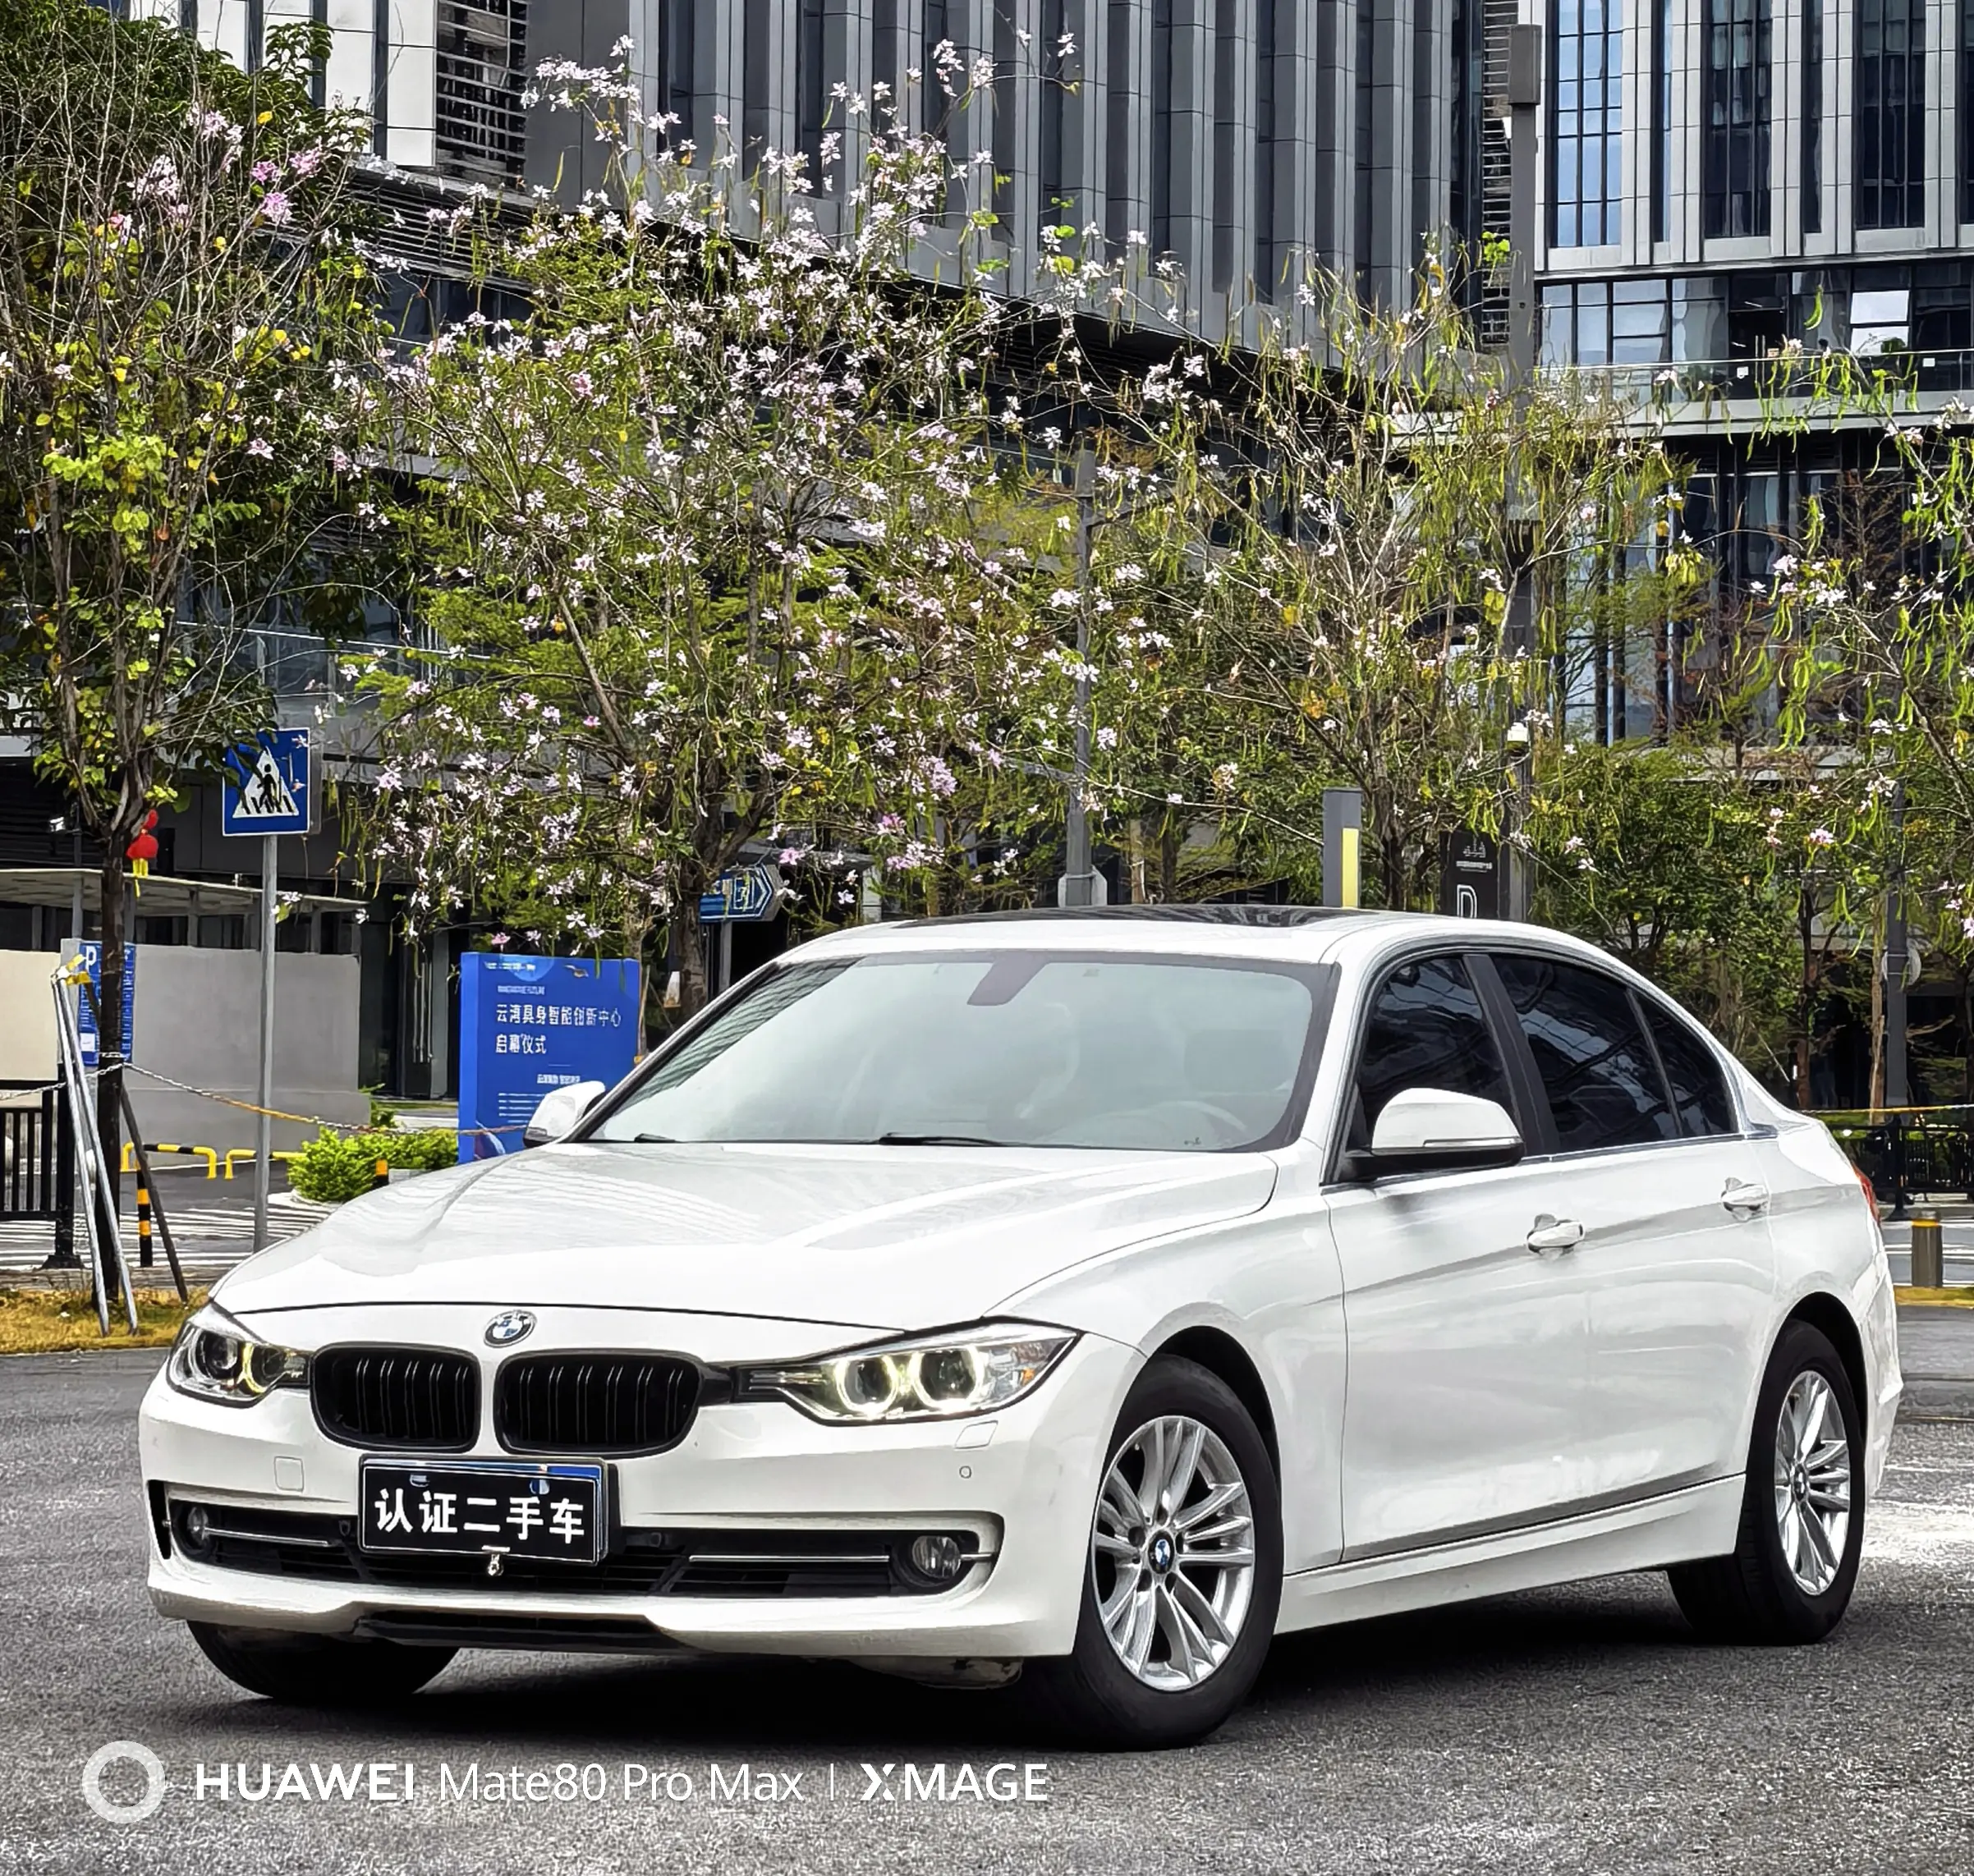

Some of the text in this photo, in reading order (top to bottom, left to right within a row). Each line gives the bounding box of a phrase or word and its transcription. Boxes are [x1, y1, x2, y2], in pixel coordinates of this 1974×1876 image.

[495, 1033, 547, 1055] 启幕仪式
[374, 1488, 585, 1544] 认证二手车
